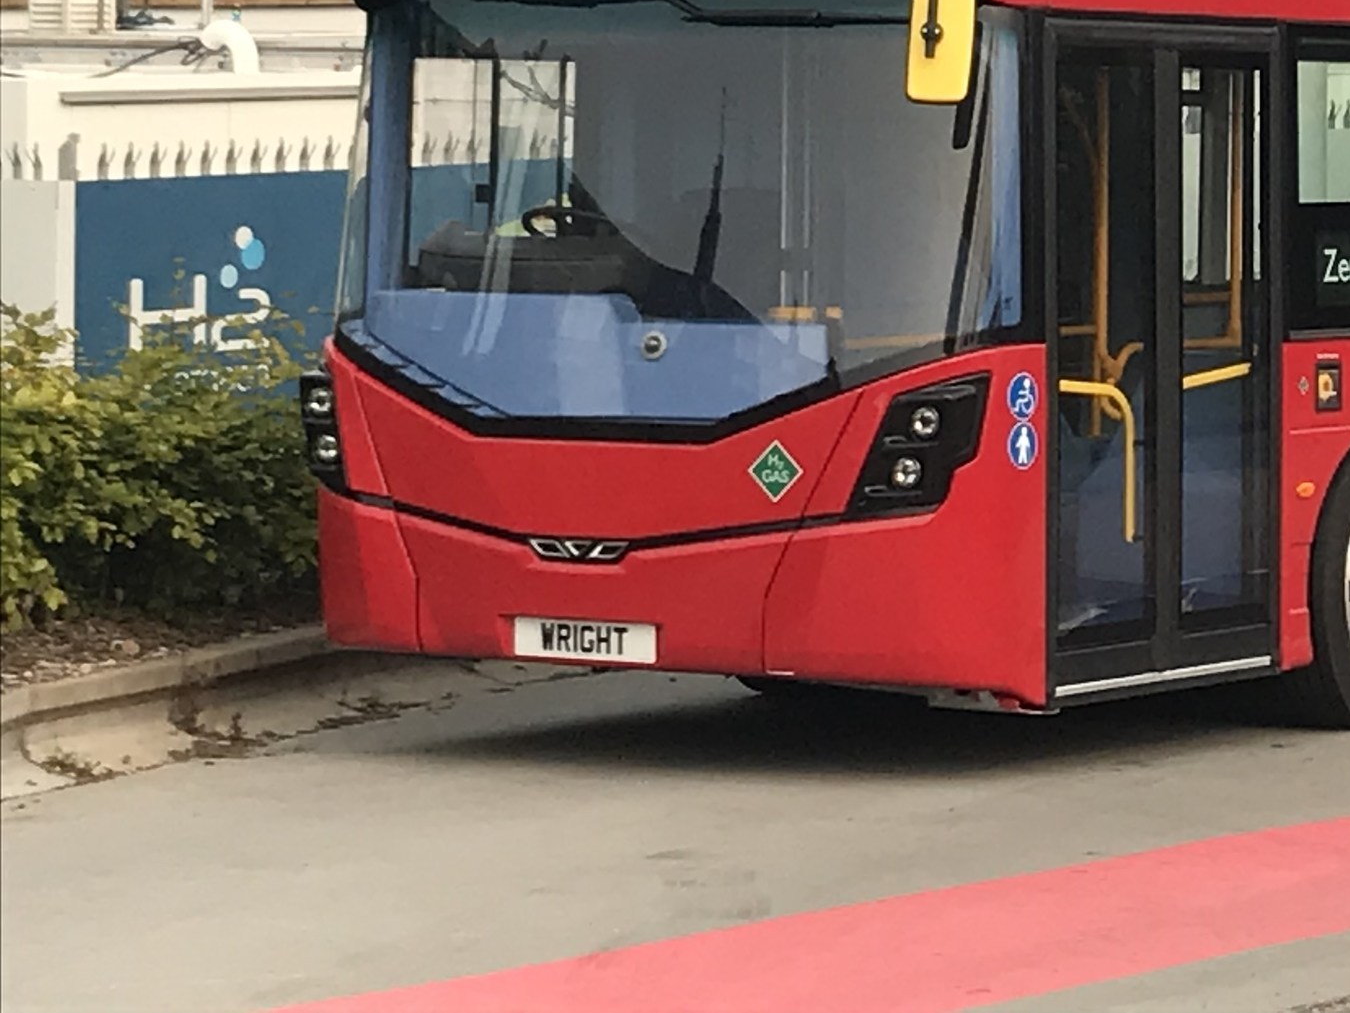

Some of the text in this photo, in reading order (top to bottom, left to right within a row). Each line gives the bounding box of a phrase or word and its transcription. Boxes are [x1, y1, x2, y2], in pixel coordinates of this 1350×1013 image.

[129, 273, 271, 352] H2
[761, 469, 790, 483] GAS
[540, 622, 629, 655] WRIGHT
